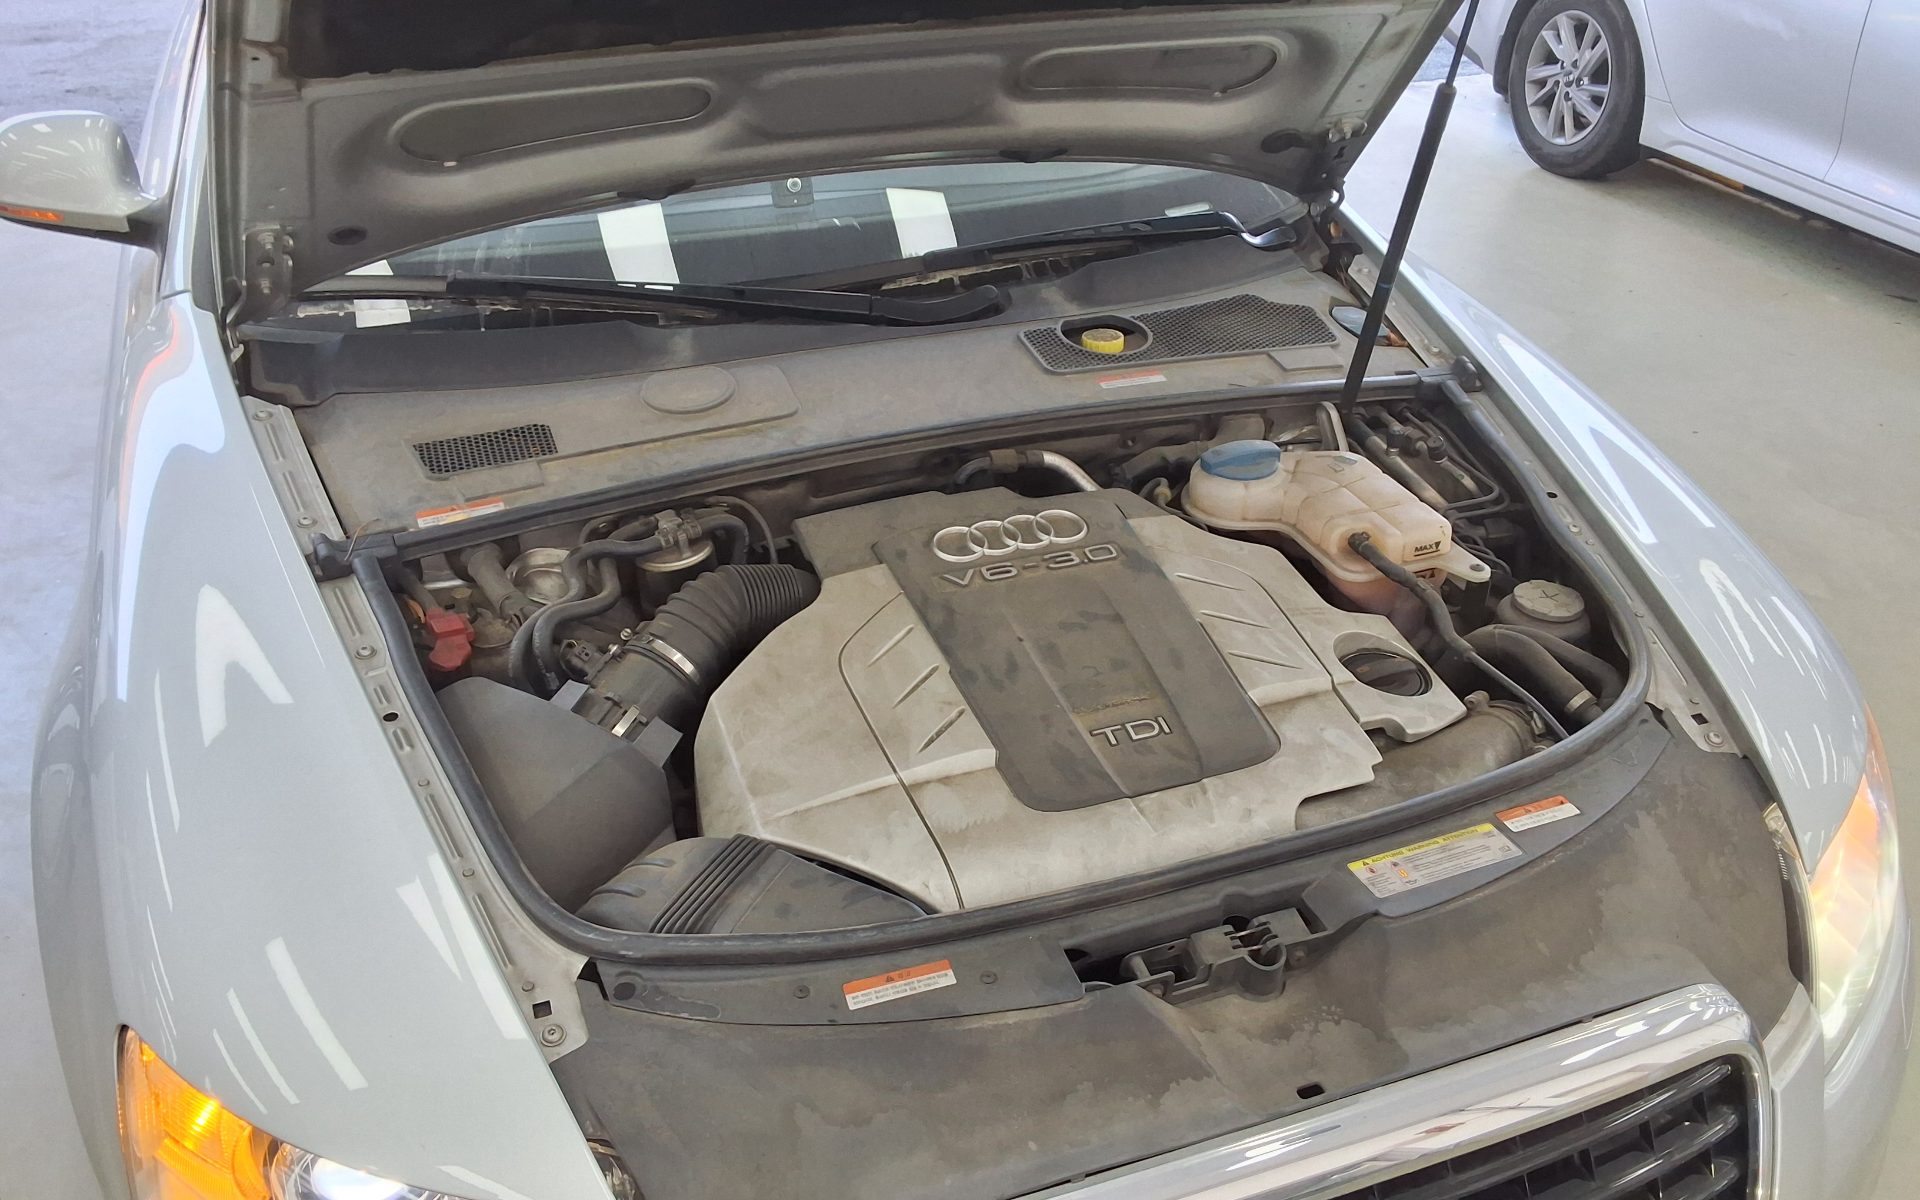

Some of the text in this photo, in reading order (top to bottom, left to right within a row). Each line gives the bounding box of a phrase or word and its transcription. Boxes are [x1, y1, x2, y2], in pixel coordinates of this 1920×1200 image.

[1414, 543, 1434, 552] MAX
[1089, 715, 1173, 748] TDI
[1371, 828, 1479, 863] ACHTUNG WARNING ATTENTION
